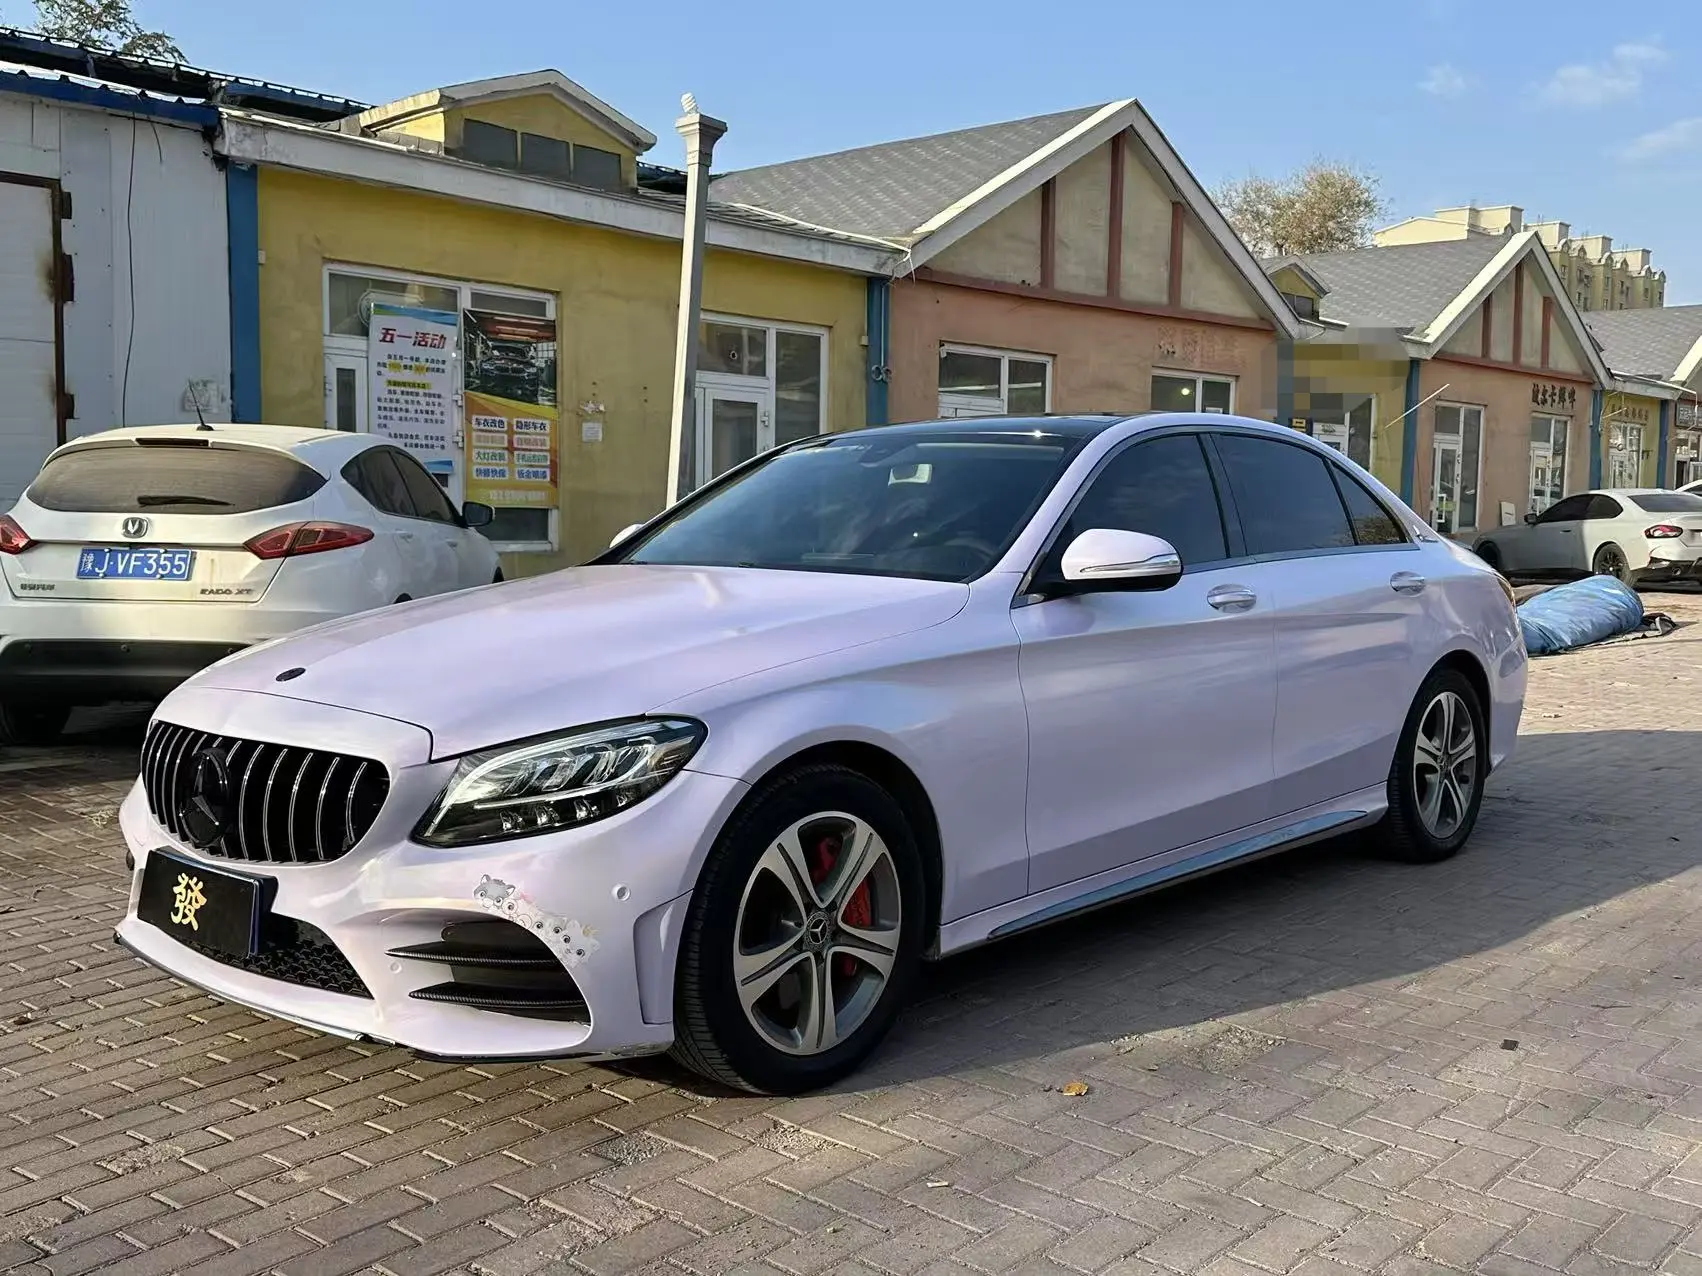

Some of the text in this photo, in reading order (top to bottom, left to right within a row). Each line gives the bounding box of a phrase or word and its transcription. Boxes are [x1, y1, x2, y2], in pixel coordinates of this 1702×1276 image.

[379, 327, 447, 349] 五一活动
[475, 417, 505, 429] 车衣改色
[515, 420, 547, 431] 隐形车衣
[170, 872, 207, 931] 發
